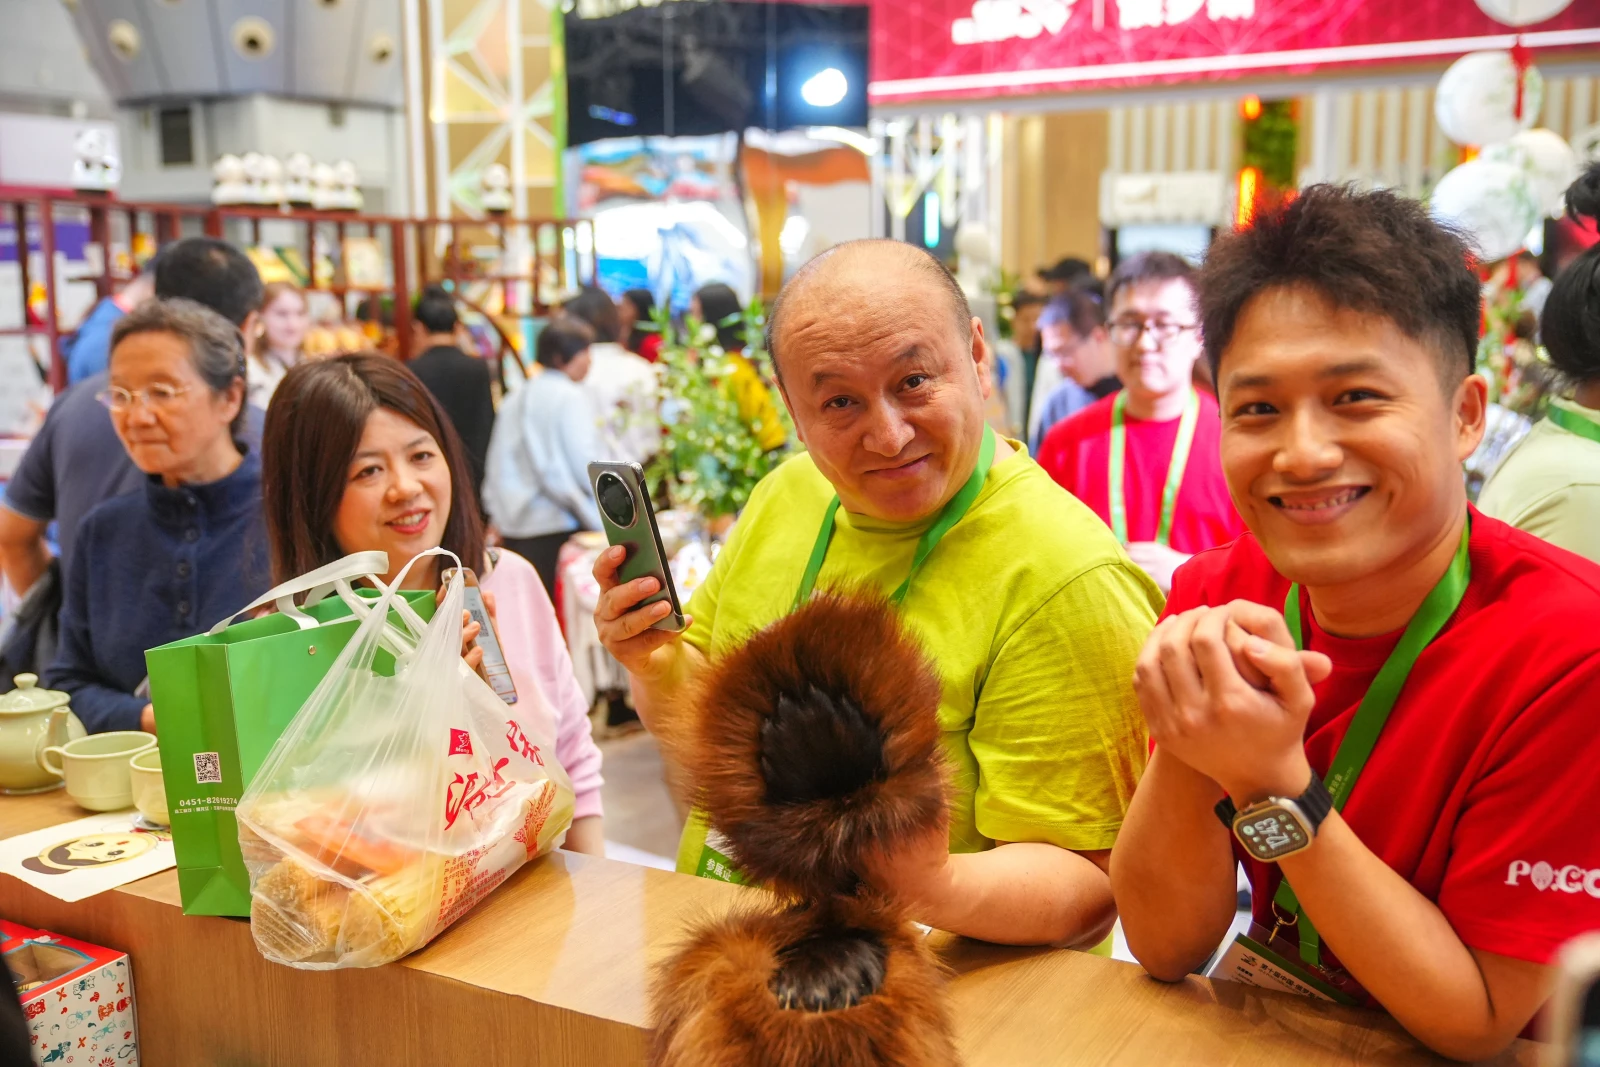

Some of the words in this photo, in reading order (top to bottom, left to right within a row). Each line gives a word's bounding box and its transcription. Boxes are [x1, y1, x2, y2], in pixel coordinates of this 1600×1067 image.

[179, 796, 238, 807] 0451-82619274
[1254, 817, 1291, 850] 12:43
[706, 858, 733, 882] 参展证
